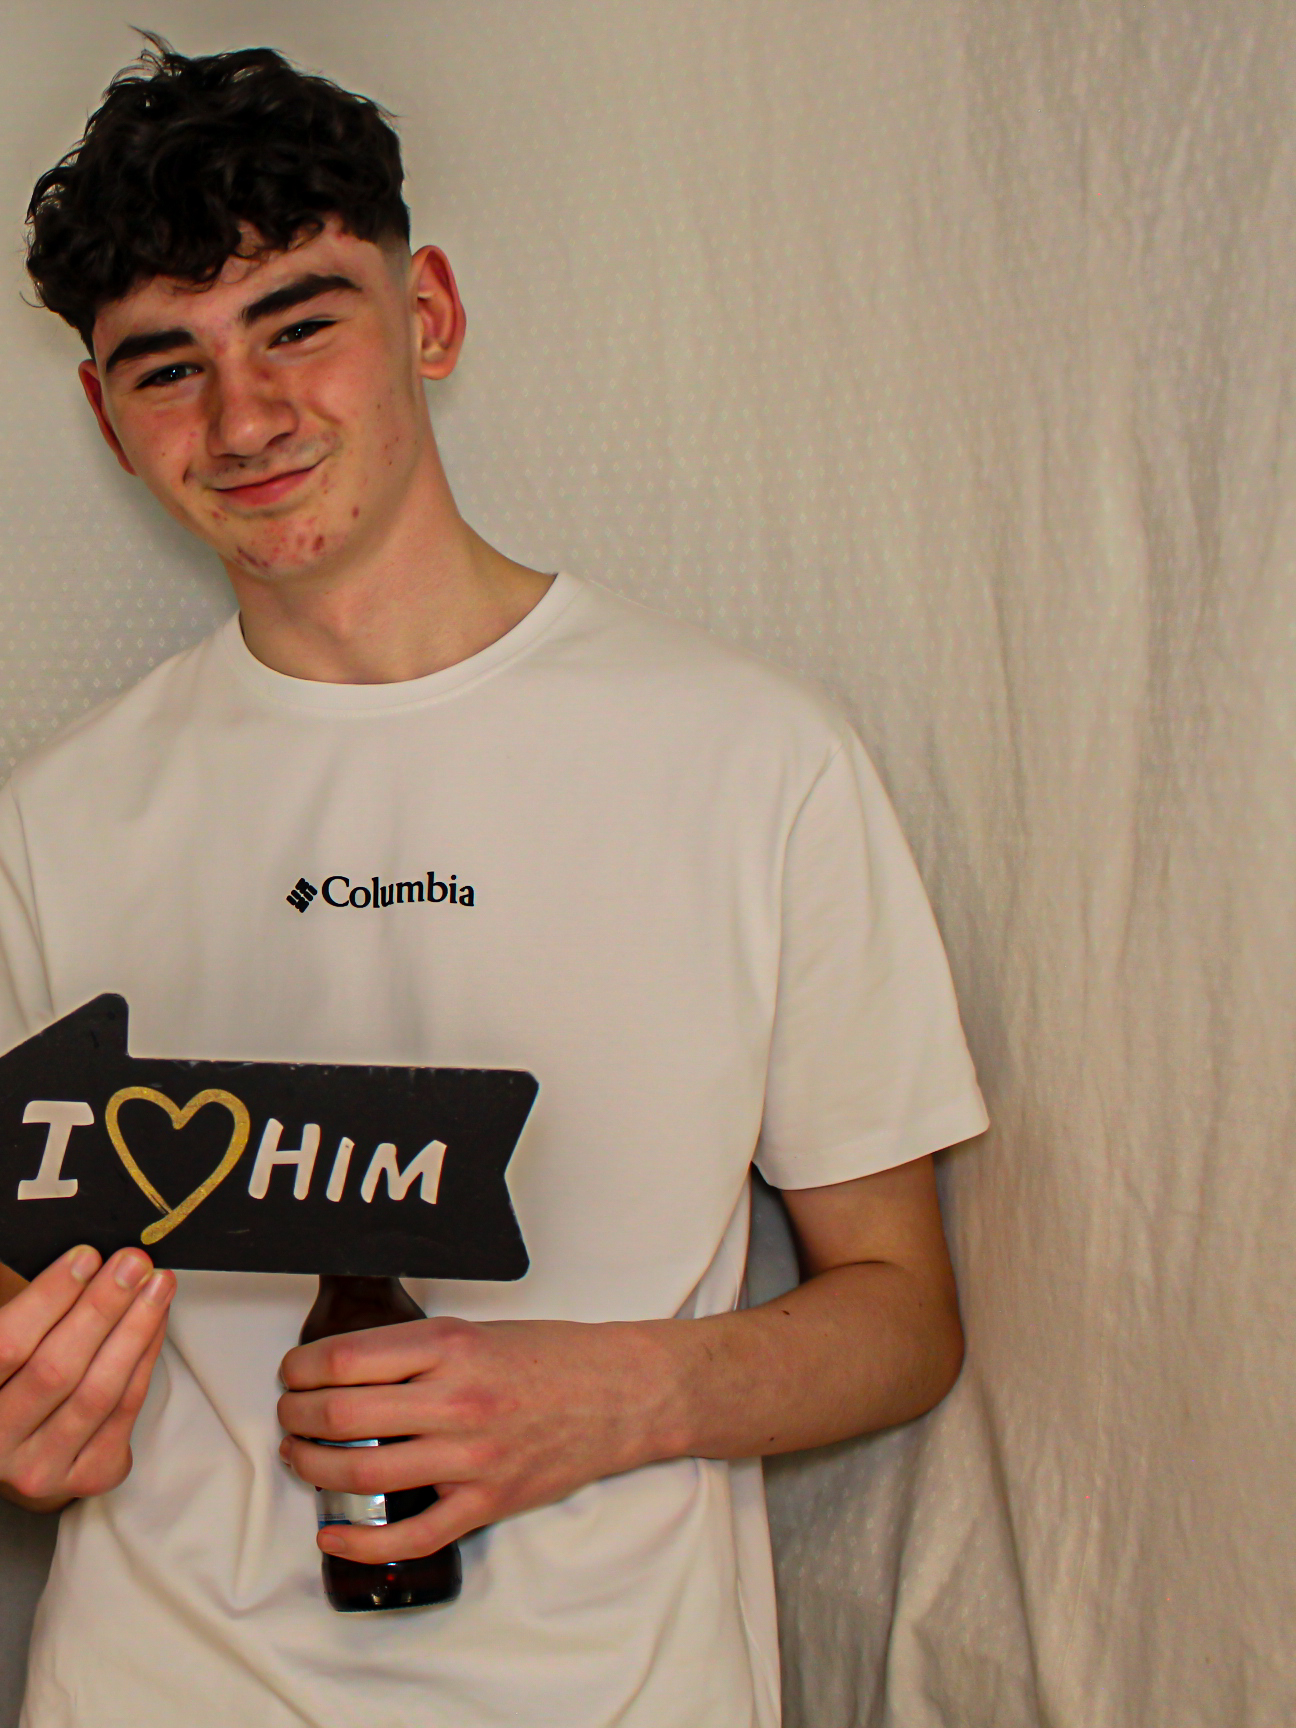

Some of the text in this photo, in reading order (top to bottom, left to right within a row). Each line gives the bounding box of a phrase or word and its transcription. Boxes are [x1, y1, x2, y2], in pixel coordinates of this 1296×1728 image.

[321, 871, 475, 908] Columbia
[17, 1100, 447, 1204] I HIM
